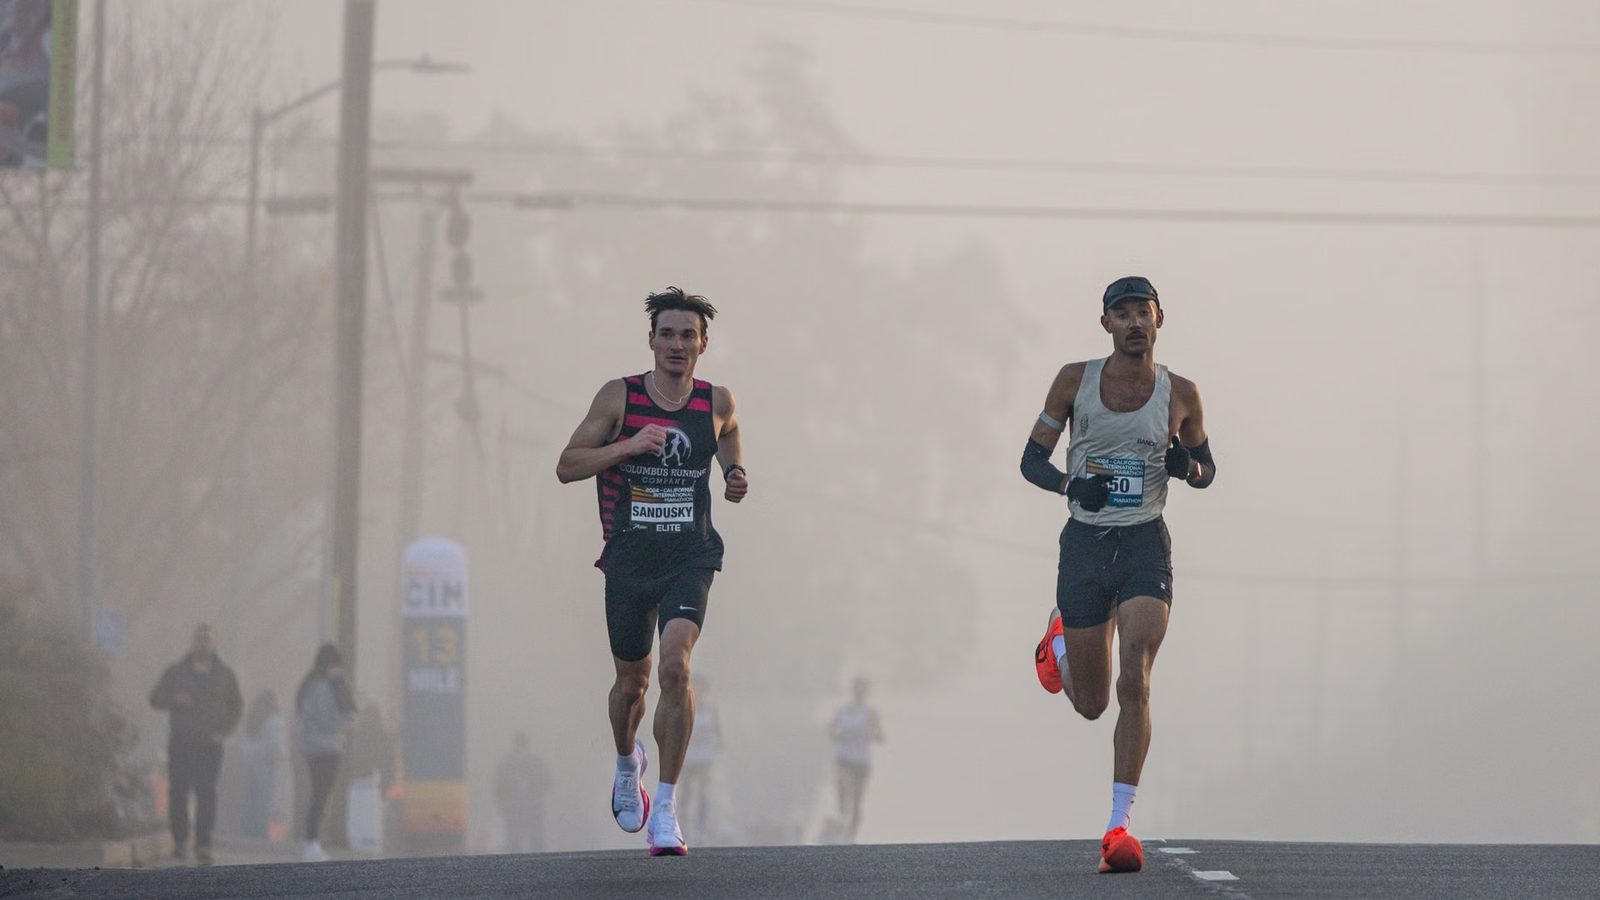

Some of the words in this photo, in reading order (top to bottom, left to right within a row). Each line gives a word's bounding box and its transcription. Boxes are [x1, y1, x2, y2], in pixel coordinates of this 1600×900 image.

[619, 464, 669, 477] COLUMBUS
[642, 477, 686, 486] COMPANY
[632, 505, 693, 519] SANDUSKY
[656, 523, 681, 532] ELITE
[405, 578, 465, 609] CIM
[413, 626, 458, 665] 13
[408, 668, 459, 693] MILE
